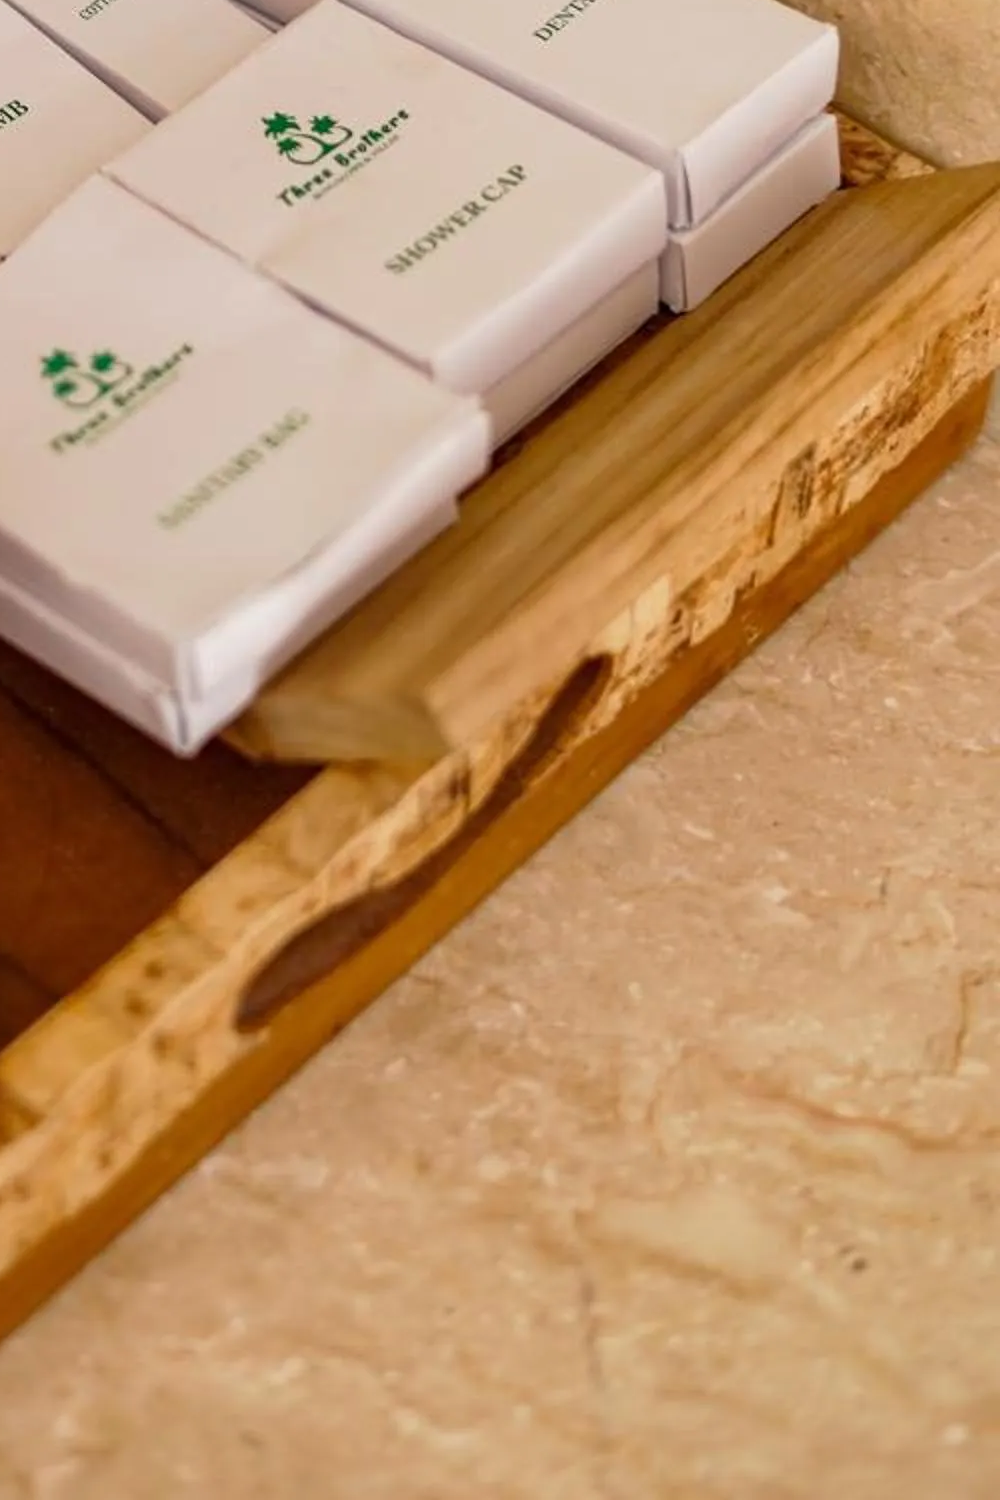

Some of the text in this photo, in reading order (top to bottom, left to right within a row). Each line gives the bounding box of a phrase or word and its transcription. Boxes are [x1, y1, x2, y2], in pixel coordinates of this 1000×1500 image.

[276, 168, 332, 206] Three
[333, 109, 409, 167] Brothers
[384, 163, 527, 275] SHOWER CAP
